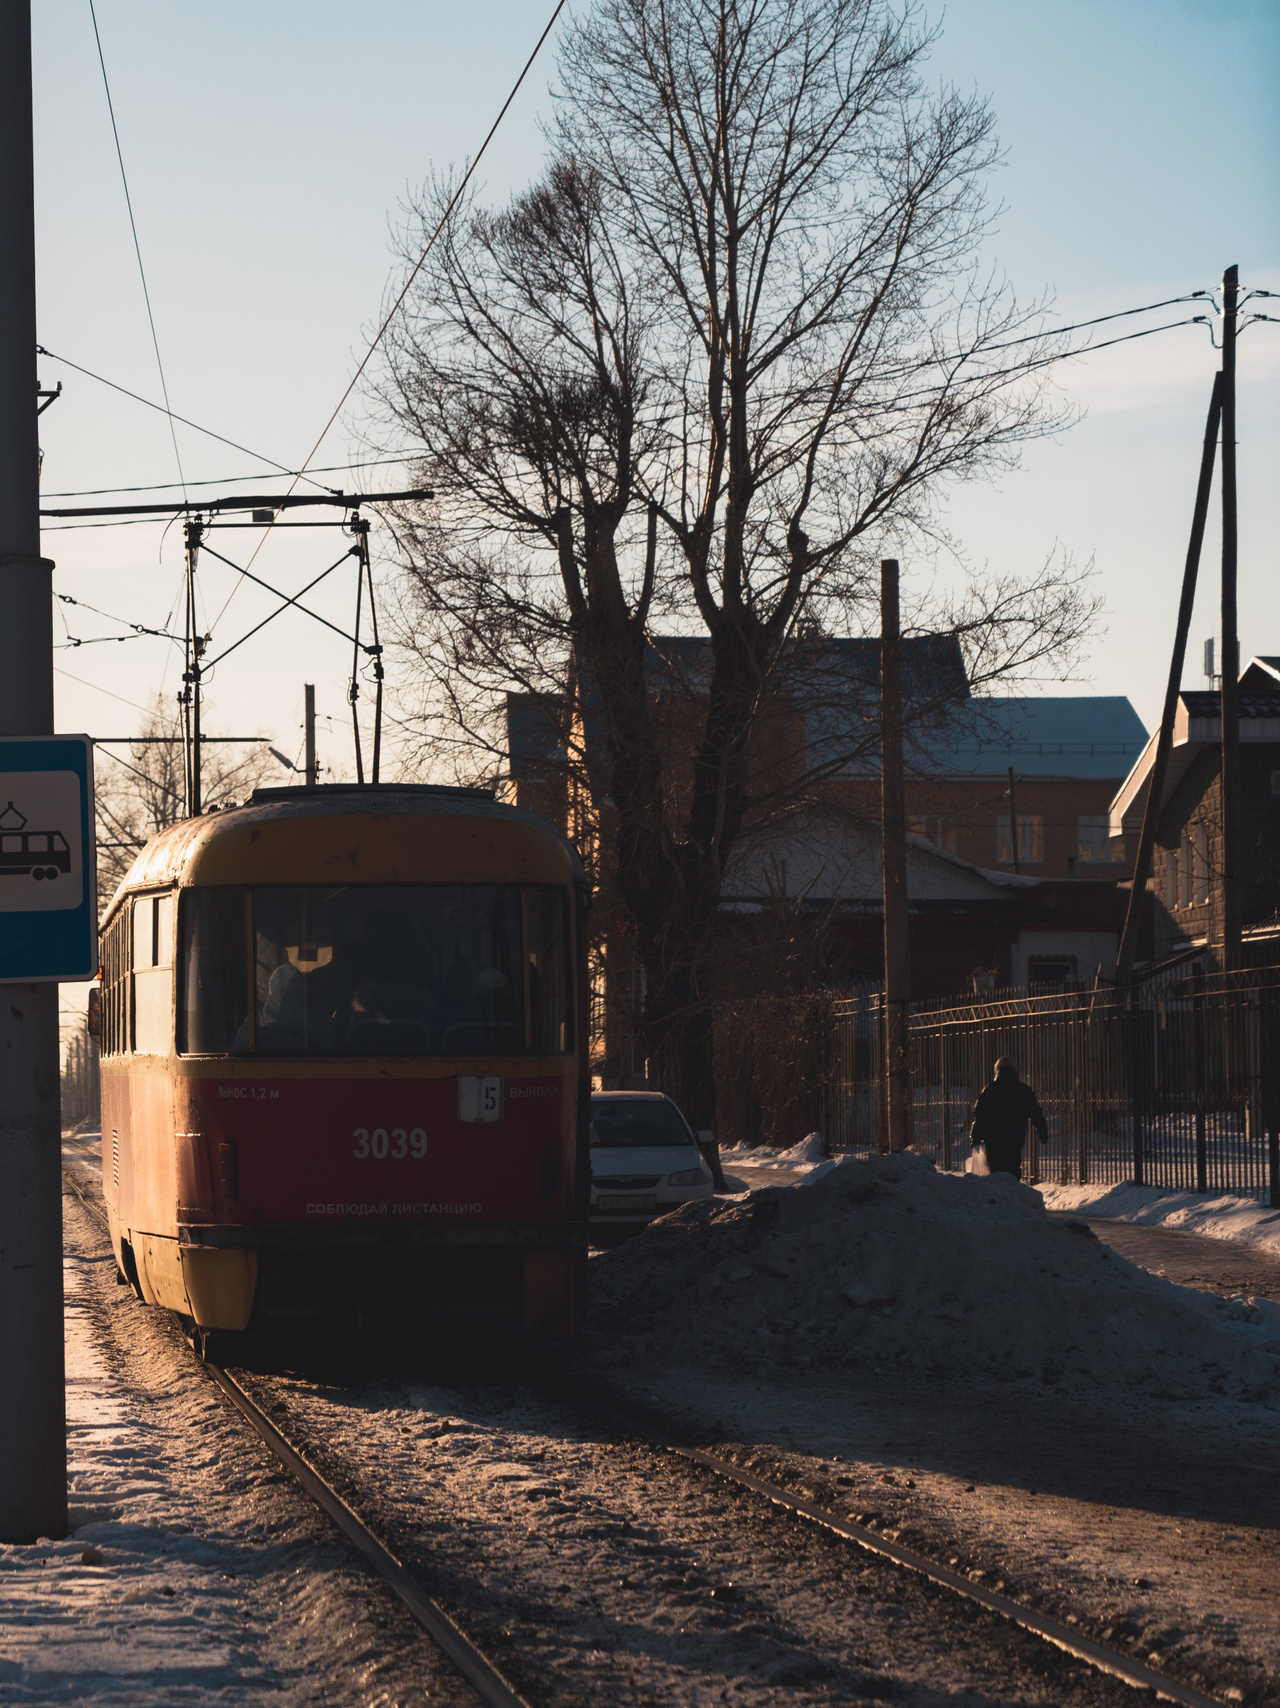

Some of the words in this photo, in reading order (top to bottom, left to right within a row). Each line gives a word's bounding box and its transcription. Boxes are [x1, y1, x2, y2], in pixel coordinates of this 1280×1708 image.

[250, 1088, 266, 1100] 1,2
[485, 1087, 496, 1110] 5
[509, 1085, 546, 1099] ВЫНОС
[352, 1127, 427, 1159] 3039
[306, 1202, 388, 1216] СОБЛЮДАЙ
[392, 1202, 482, 1216] ДИСТАНЦИЮ
